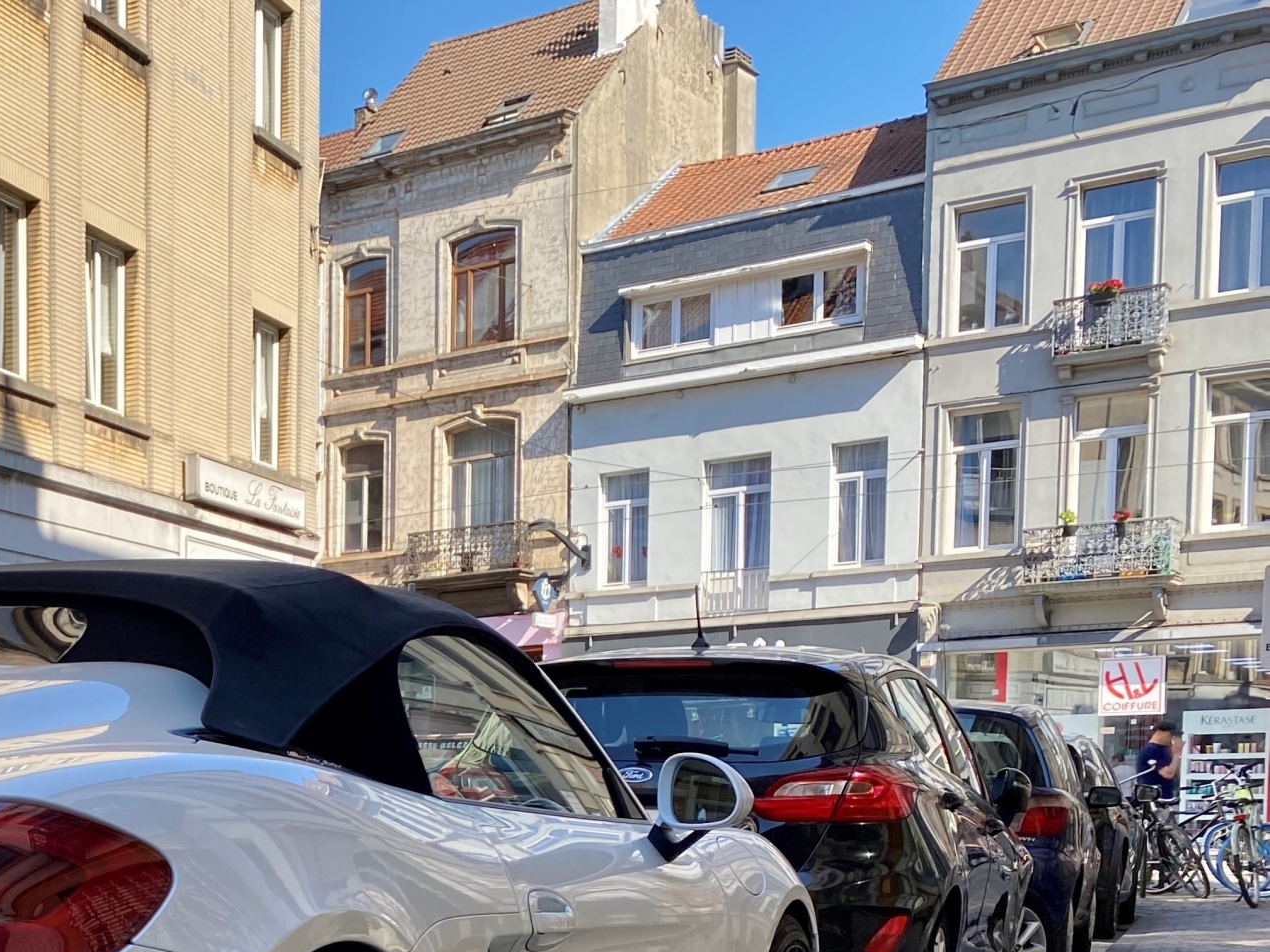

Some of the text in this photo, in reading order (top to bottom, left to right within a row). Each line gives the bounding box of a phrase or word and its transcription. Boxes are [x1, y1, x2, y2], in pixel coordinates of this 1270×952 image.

[204, 479, 302, 520] BOUTIQUE La Fantaisie
[1102, 700, 1158, 712] COIFFURE
[1200, 713, 1257, 726] KÉRASTASE
[622, 770, 644, 780] Ford
